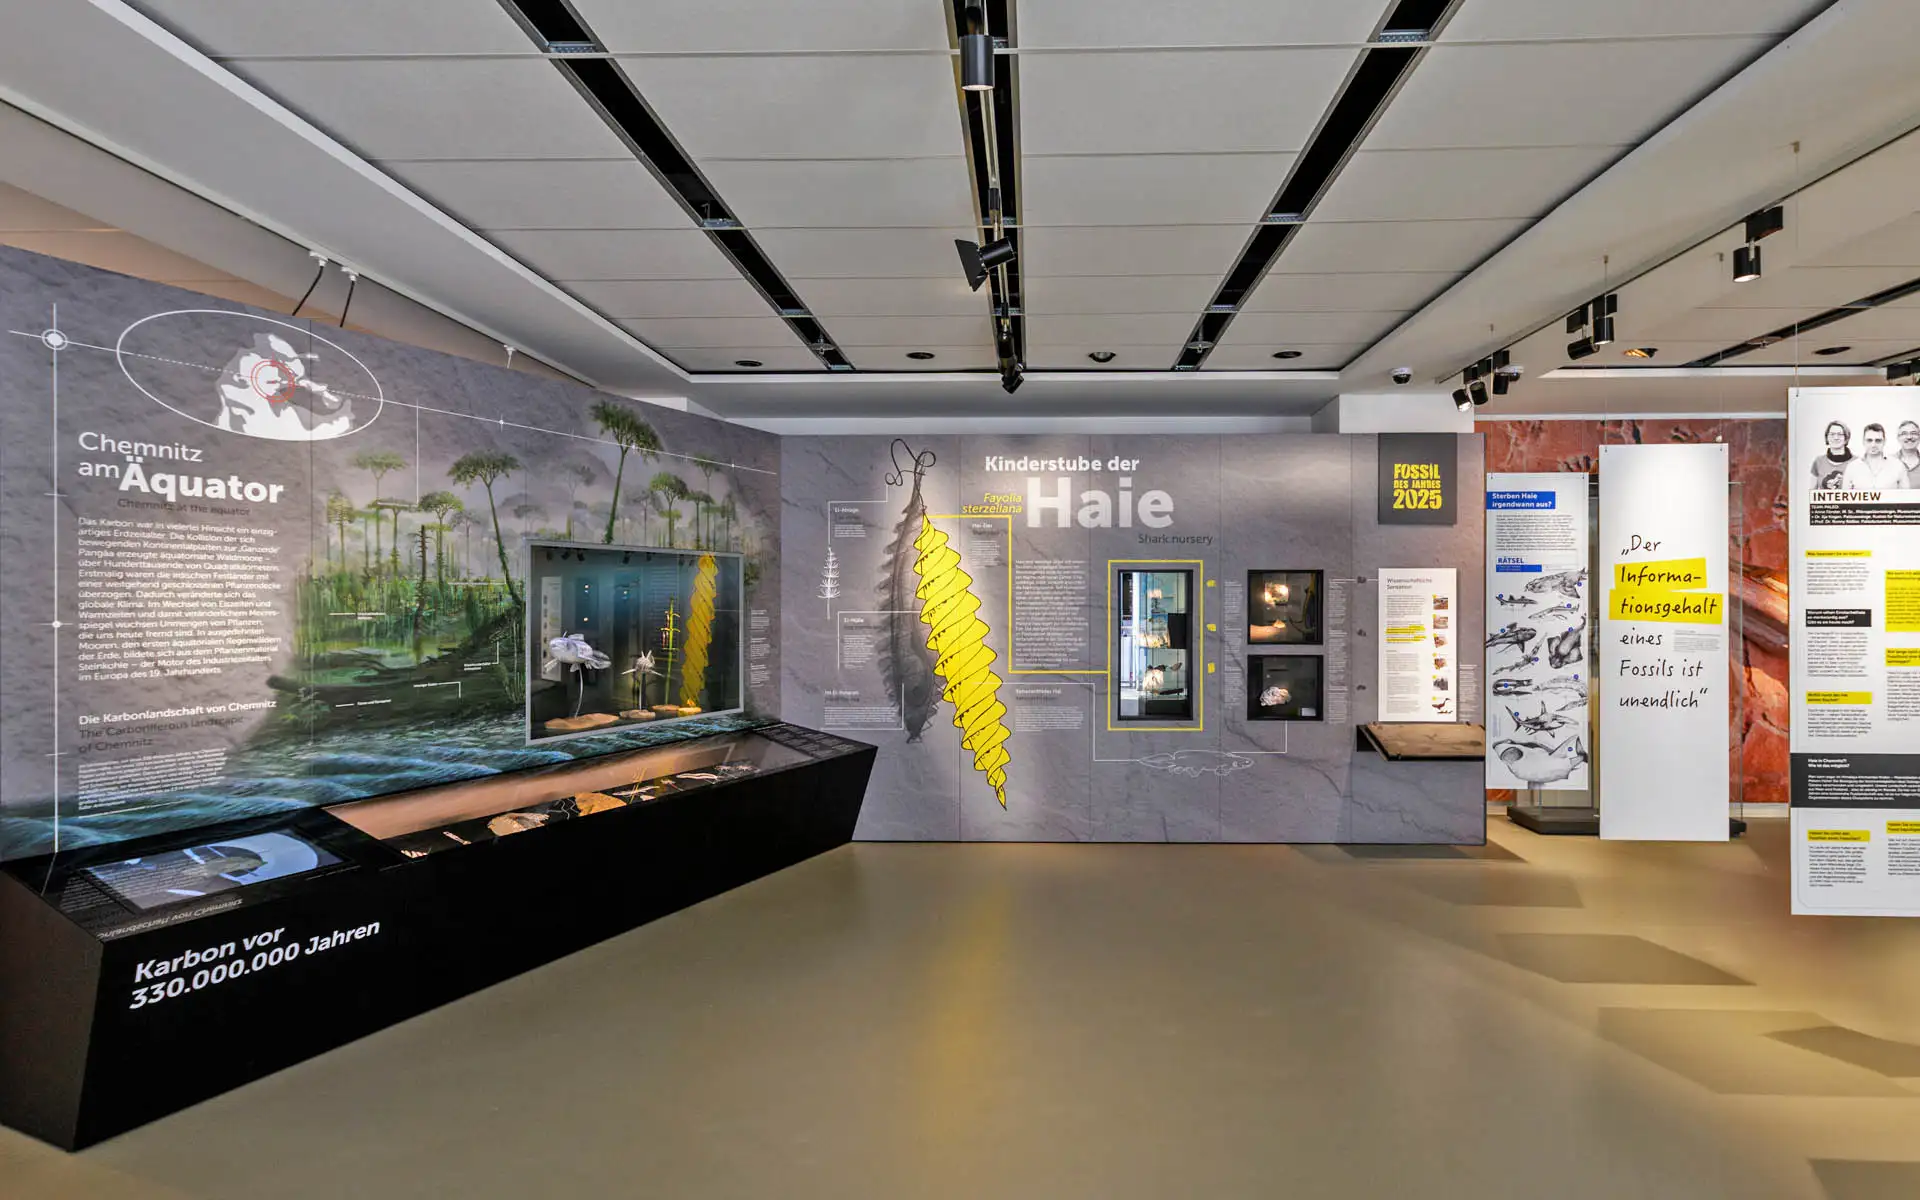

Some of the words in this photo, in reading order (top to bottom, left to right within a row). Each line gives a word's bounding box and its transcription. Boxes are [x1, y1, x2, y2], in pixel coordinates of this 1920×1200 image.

[78, 432, 203, 462] Chemnitz
[985, 456, 1103, 472] Kinderstube
[1107, 456, 1140, 471] der
[1394, 463, 1441, 479] FOSSIL
[78, 461, 120, 479] am
[119, 455, 284, 503] Äquator
[1394, 480, 1409, 489] DES
[1411, 480, 1441, 489] JAHRES
[117, 498, 175, 511] Chemnitz
[176, 503, 187, 512] at
[190, 504, 208, 513] the
[983, 492, 1022, 505] Fayolia
[1026, 476, 1175, 529] Haie
[1393, 489, 1442, 509] 2025
[1492, 501, 1535, 509] irgendwann
[1813, 492, 1882, 501] INTERVIEW
[1138, 533, 1169, 544] Shark
[1171, 534, 1213, 546] nursery
[1621, 534, 1661, 556] „Der
[1497, 556, 1524, 564] RÄTSEL
[1621, 565, 1702, 587] Informa-
[1621, 596, 1717, 618] tionsgehalt
[1619, 627, 1663, 645] eines
[1620, 658, 1674, 678] Fossils
[1682, 659, 1703, 677] ist
[79, 714, 101, 726] Die
[103, 705, 205, 723] Karbonlandschaft
[206, 704, 227, 714] von
[228, 698, 278, 712] Chemnitz
[79, 728, 101, 740] The
[105, 720, 189, 738] Carboniferous
[78, 742, 93, 754] of
[95, 737, 153, 752] Chemnitz
[129, 942, 300, 1009] 330.000.000
[304, 921, 381, 955] Jahren
[133, 940, 236, 983] Karbon
[242, 927, 286, 949] vor
